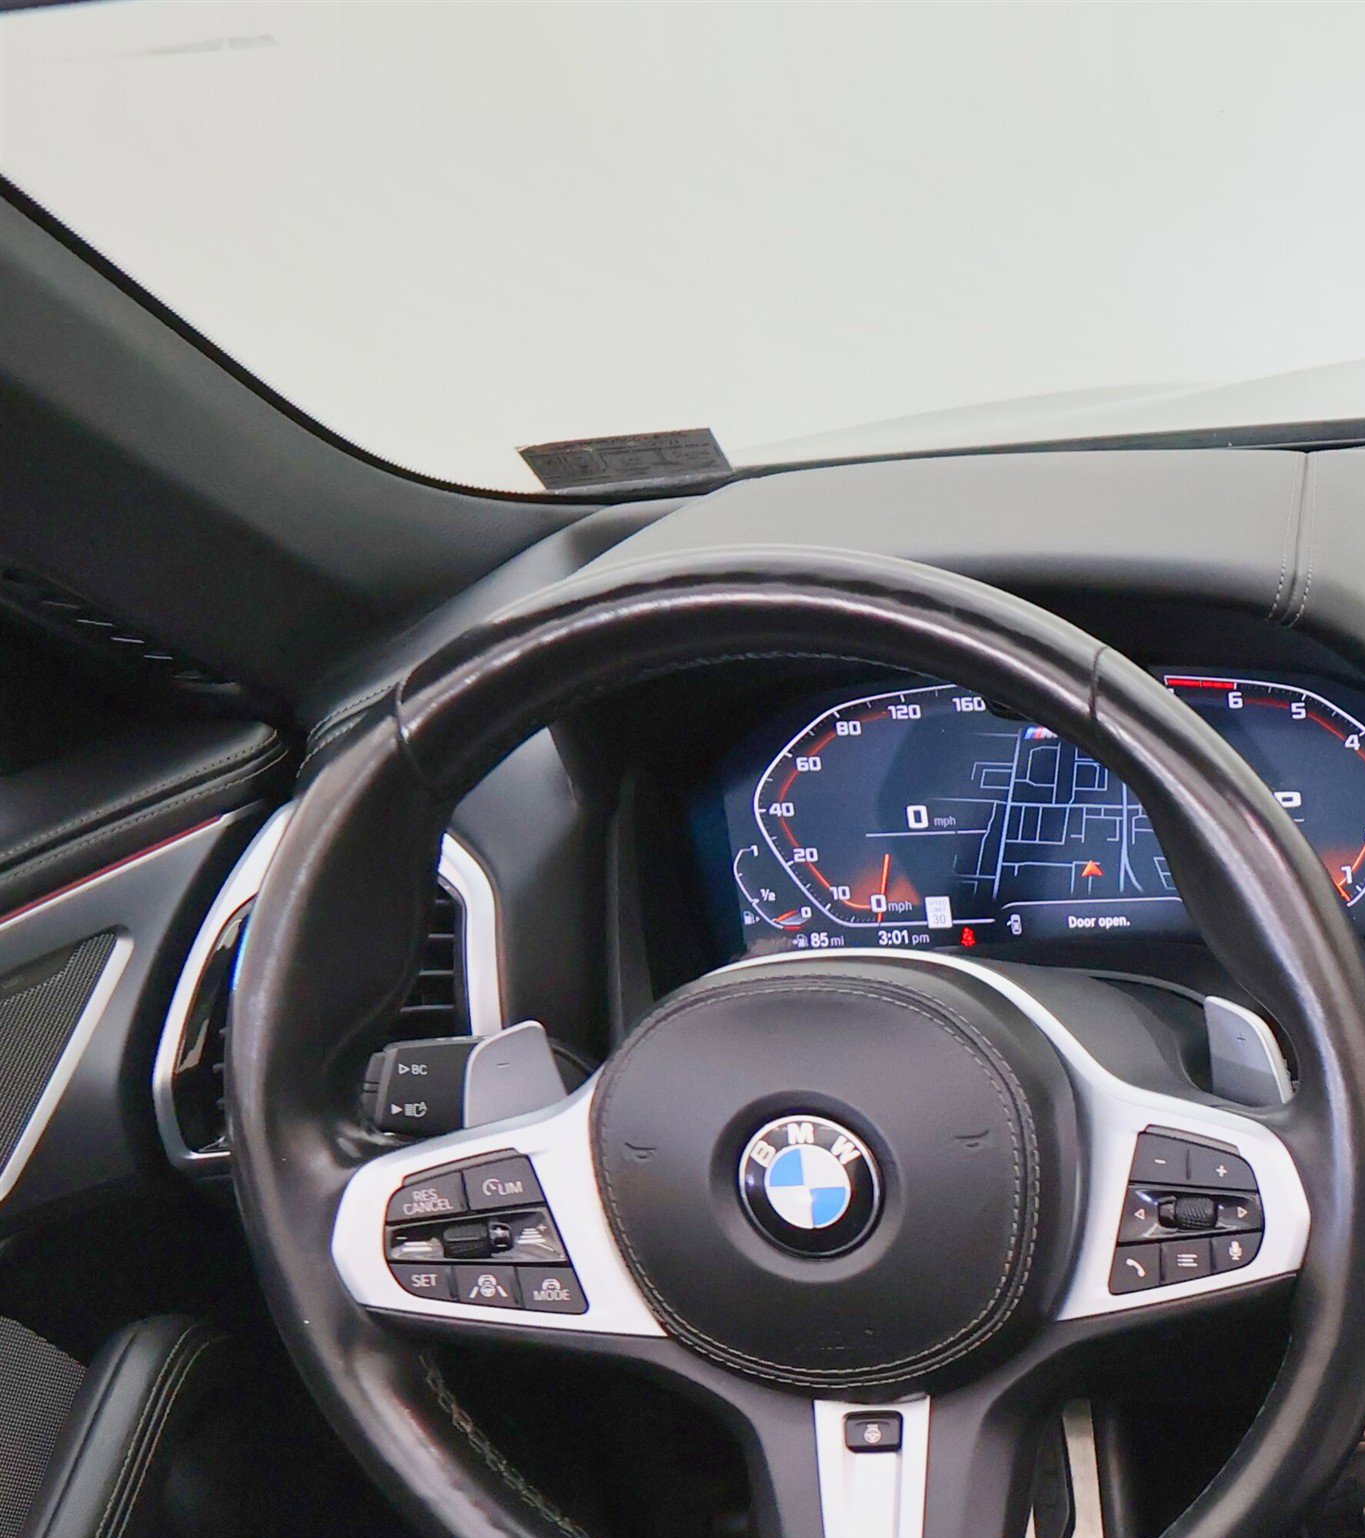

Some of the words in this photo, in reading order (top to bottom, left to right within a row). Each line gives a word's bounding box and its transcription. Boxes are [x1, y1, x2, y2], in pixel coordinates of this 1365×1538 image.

[952, 697, 986, 712] 160
[1228, 691, 1243, 709] 6
[887, 704, 922, 720] 120
[1290, 702, 1307, 719] 5
[835, 721, 862, 736] 80
[1344, 734, 1361, 750] 4
[796, 756, 822, 772] 60
[769, 802, 795, 818] 40
[906, 805, 929, 829] 0
[934, 815, 957, 828] mph
[750, 845, 760, 857] 1
[793, 848, 819, 863] 20
[1341, 865, 1353, 884] 1
[829, 885, 851, 901] 10
[870, 894, 887, 913] 0
[888, 900, 913, 914] mph
[800, 906, 812, 919] 0
[932, 913, 947, 925] 30
[1068, 916, 1096, 929] Door
[1098, 915, 1131, 930] open.
[810, 931, 829, 947] 85
[830, 934, 845, 947] mi
[878, 930, 909, 946] 3:01
[912, 935, 930, 947] pm
[411, 1064, 428, 1076] BC
[750, 1122, 861, 1168] BMW
[413, 1188, 438, 1201] RES
[499, 1181, 523, 1195] LIM
[403, 1198, 454, 1216] CANCEL
[411, 1274, 438, 1288] SET
[533, 1289, 571, 1301] MODE
